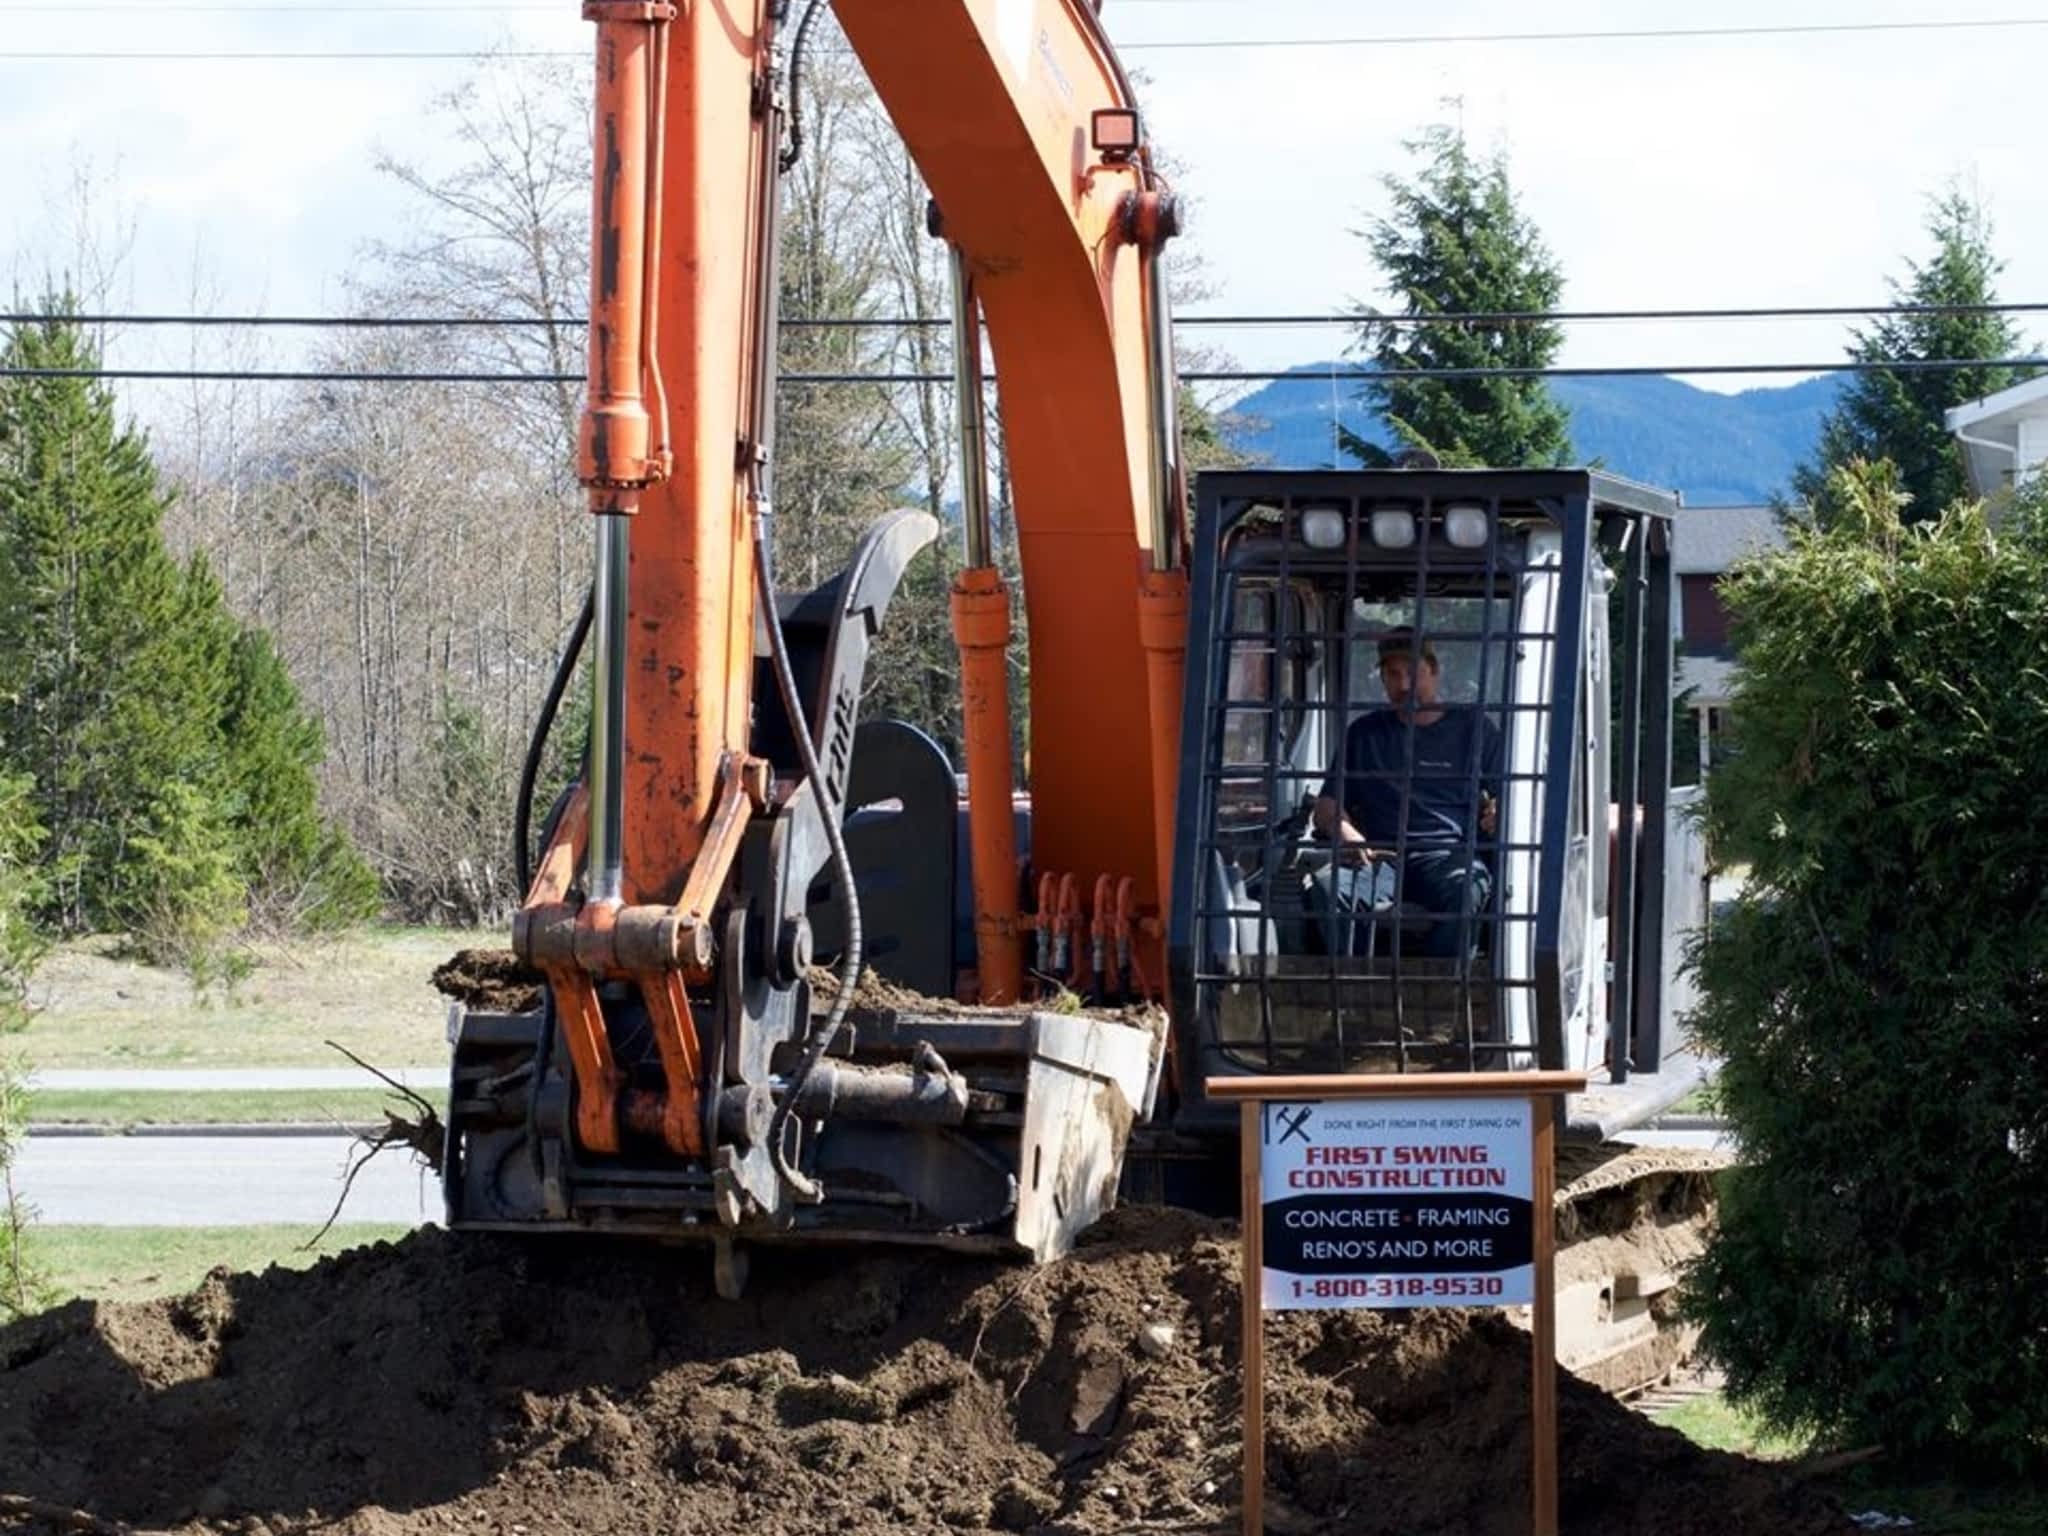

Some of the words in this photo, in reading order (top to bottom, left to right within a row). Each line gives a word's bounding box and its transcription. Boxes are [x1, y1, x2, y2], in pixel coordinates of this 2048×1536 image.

[1306, 1146, 1387, 1165] FIRST
[1394, 1145, 1488, 1164] SWING
[1288, 1168, 1505, 1188] CONSTRUCTION
[1285, 1209, 1400, 1227] CONCRETE
[1417, 1208, 1510, 1226] FRAMING
[1302, 1241, 1377, 1259] RENO'S
[1379, 1240, 1428, 1258] AND
[1434, 1239, 1493, 1257] MORE
[1292, 1277, 1503, 1298] 1-800-318-9530
